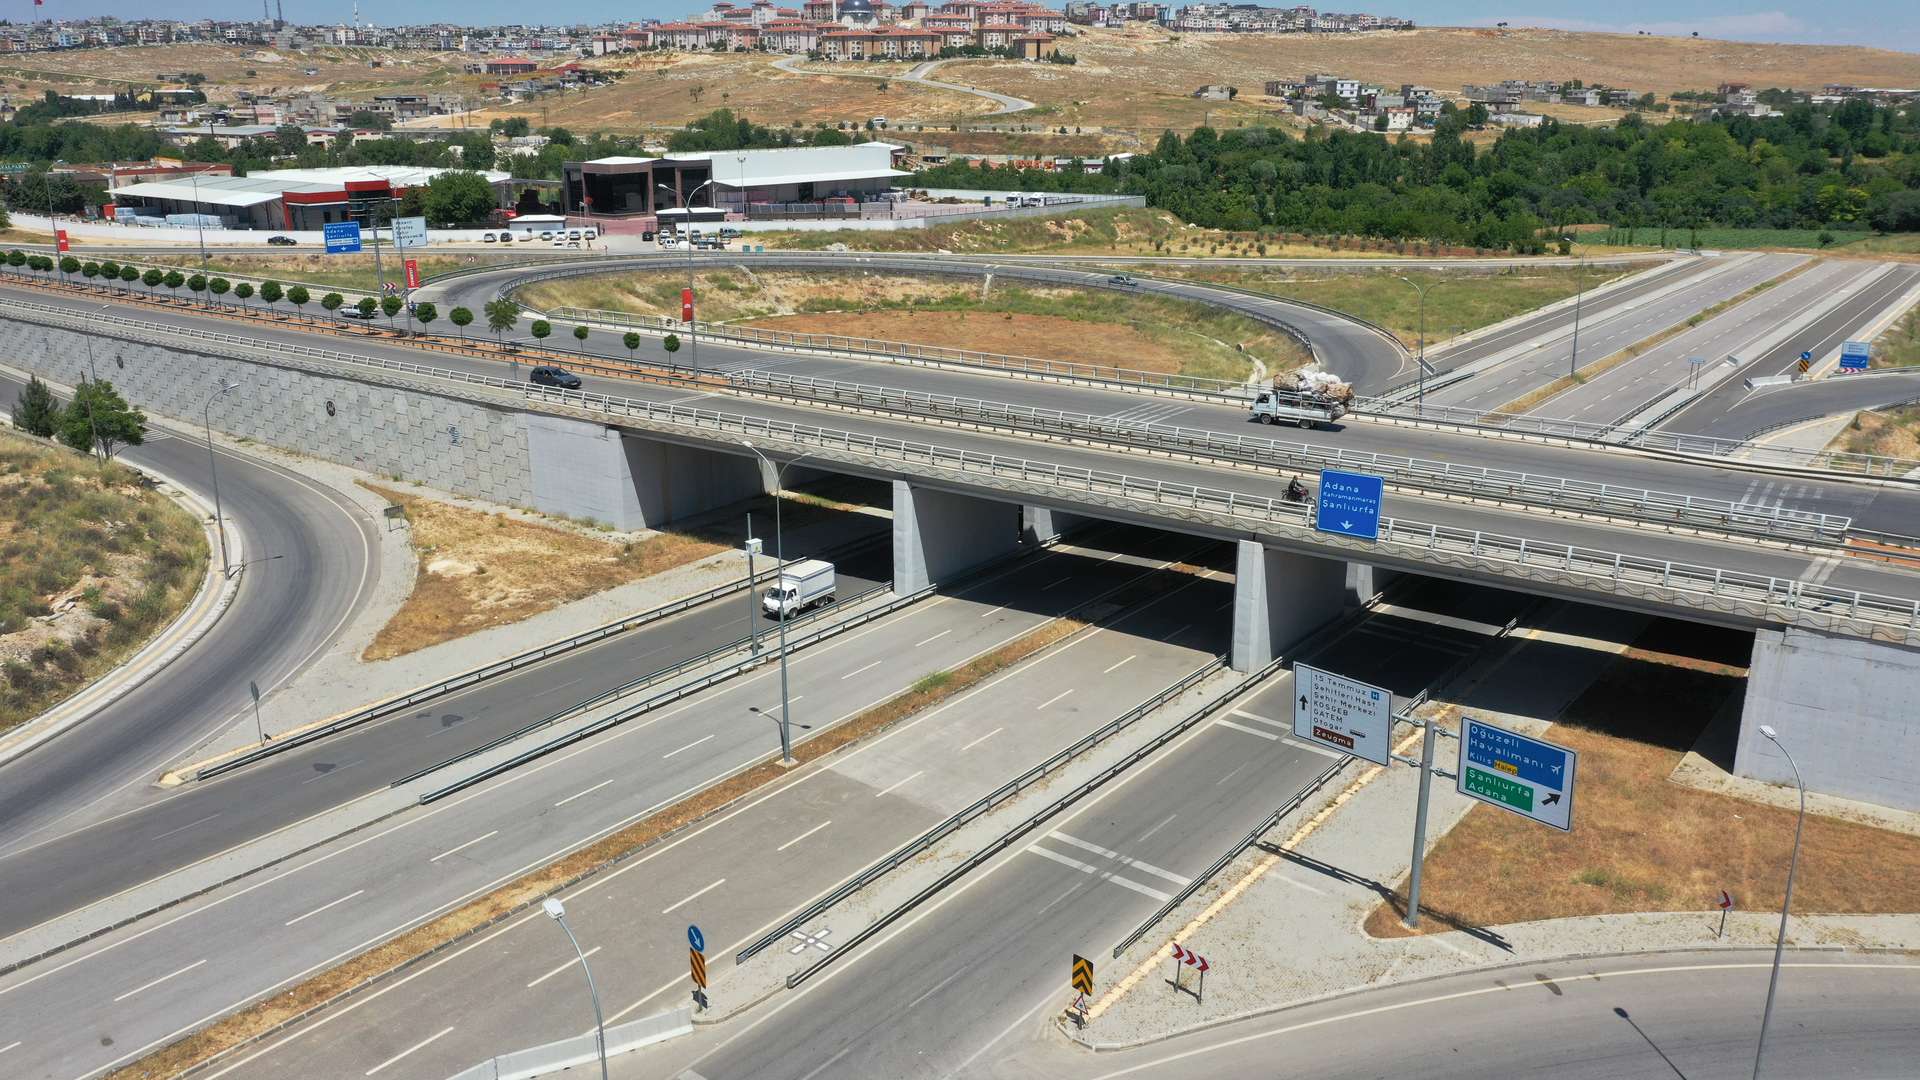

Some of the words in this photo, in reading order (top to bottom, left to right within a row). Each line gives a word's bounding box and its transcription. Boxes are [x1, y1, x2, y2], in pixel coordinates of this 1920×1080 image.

[1324, 481, 1359, 493] Adana
[1314, 674, 1324, 682] 15
[1327, 678, 1367, 696] Temmuz
[1313, 700, 1348, 716] KOSGEB
[1313, 708, 1343, 723] GATEM
[1340, 700, 1376, 716] Merkezi
[1313, 717, 1342, 731] Otogar
[1315, 729, 1352, 746] Zeugma
[1471, 726, 1519, 748] Oğuzeli
[1469, 752, 1492, 765] Kilis
[1470, 738, 1543, 768] Havalimanı
[1468, 782, 1507, 801] Adana
